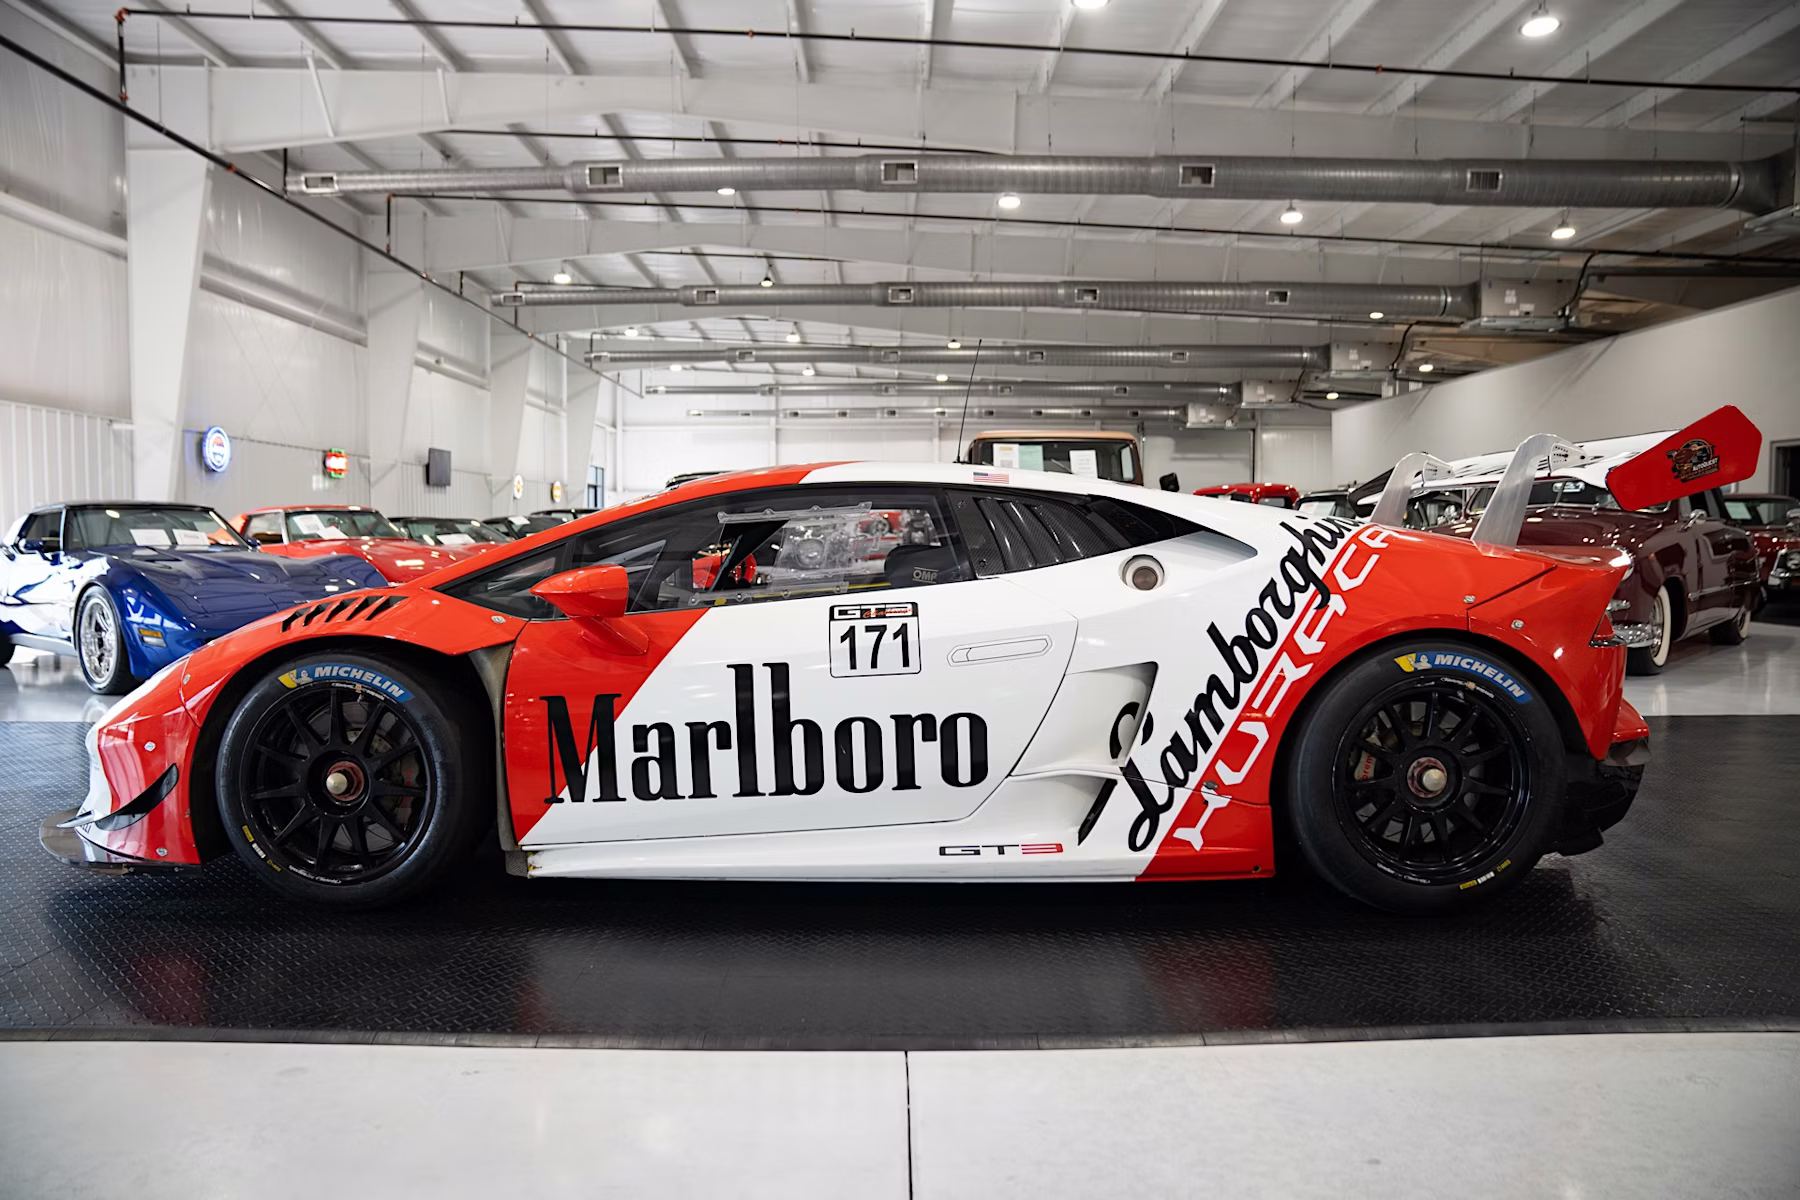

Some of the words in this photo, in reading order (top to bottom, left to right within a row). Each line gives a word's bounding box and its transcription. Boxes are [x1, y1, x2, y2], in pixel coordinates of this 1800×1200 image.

[913, 569, 938, 582] OMP
[840, 622, 910, 670] 171
[314, 665, 405, 698] MICHELIN
[1078, 516, 1366, 852] Lamborghin
[1172, 528, 1391, 852] HURACA
[1434, 654, 1526, 698] MICHELIN
[539, 662, 989, 805] Marlboro
[1360, 753, 1373, 781] brem
[938, 843, 1064, 856] GT3
